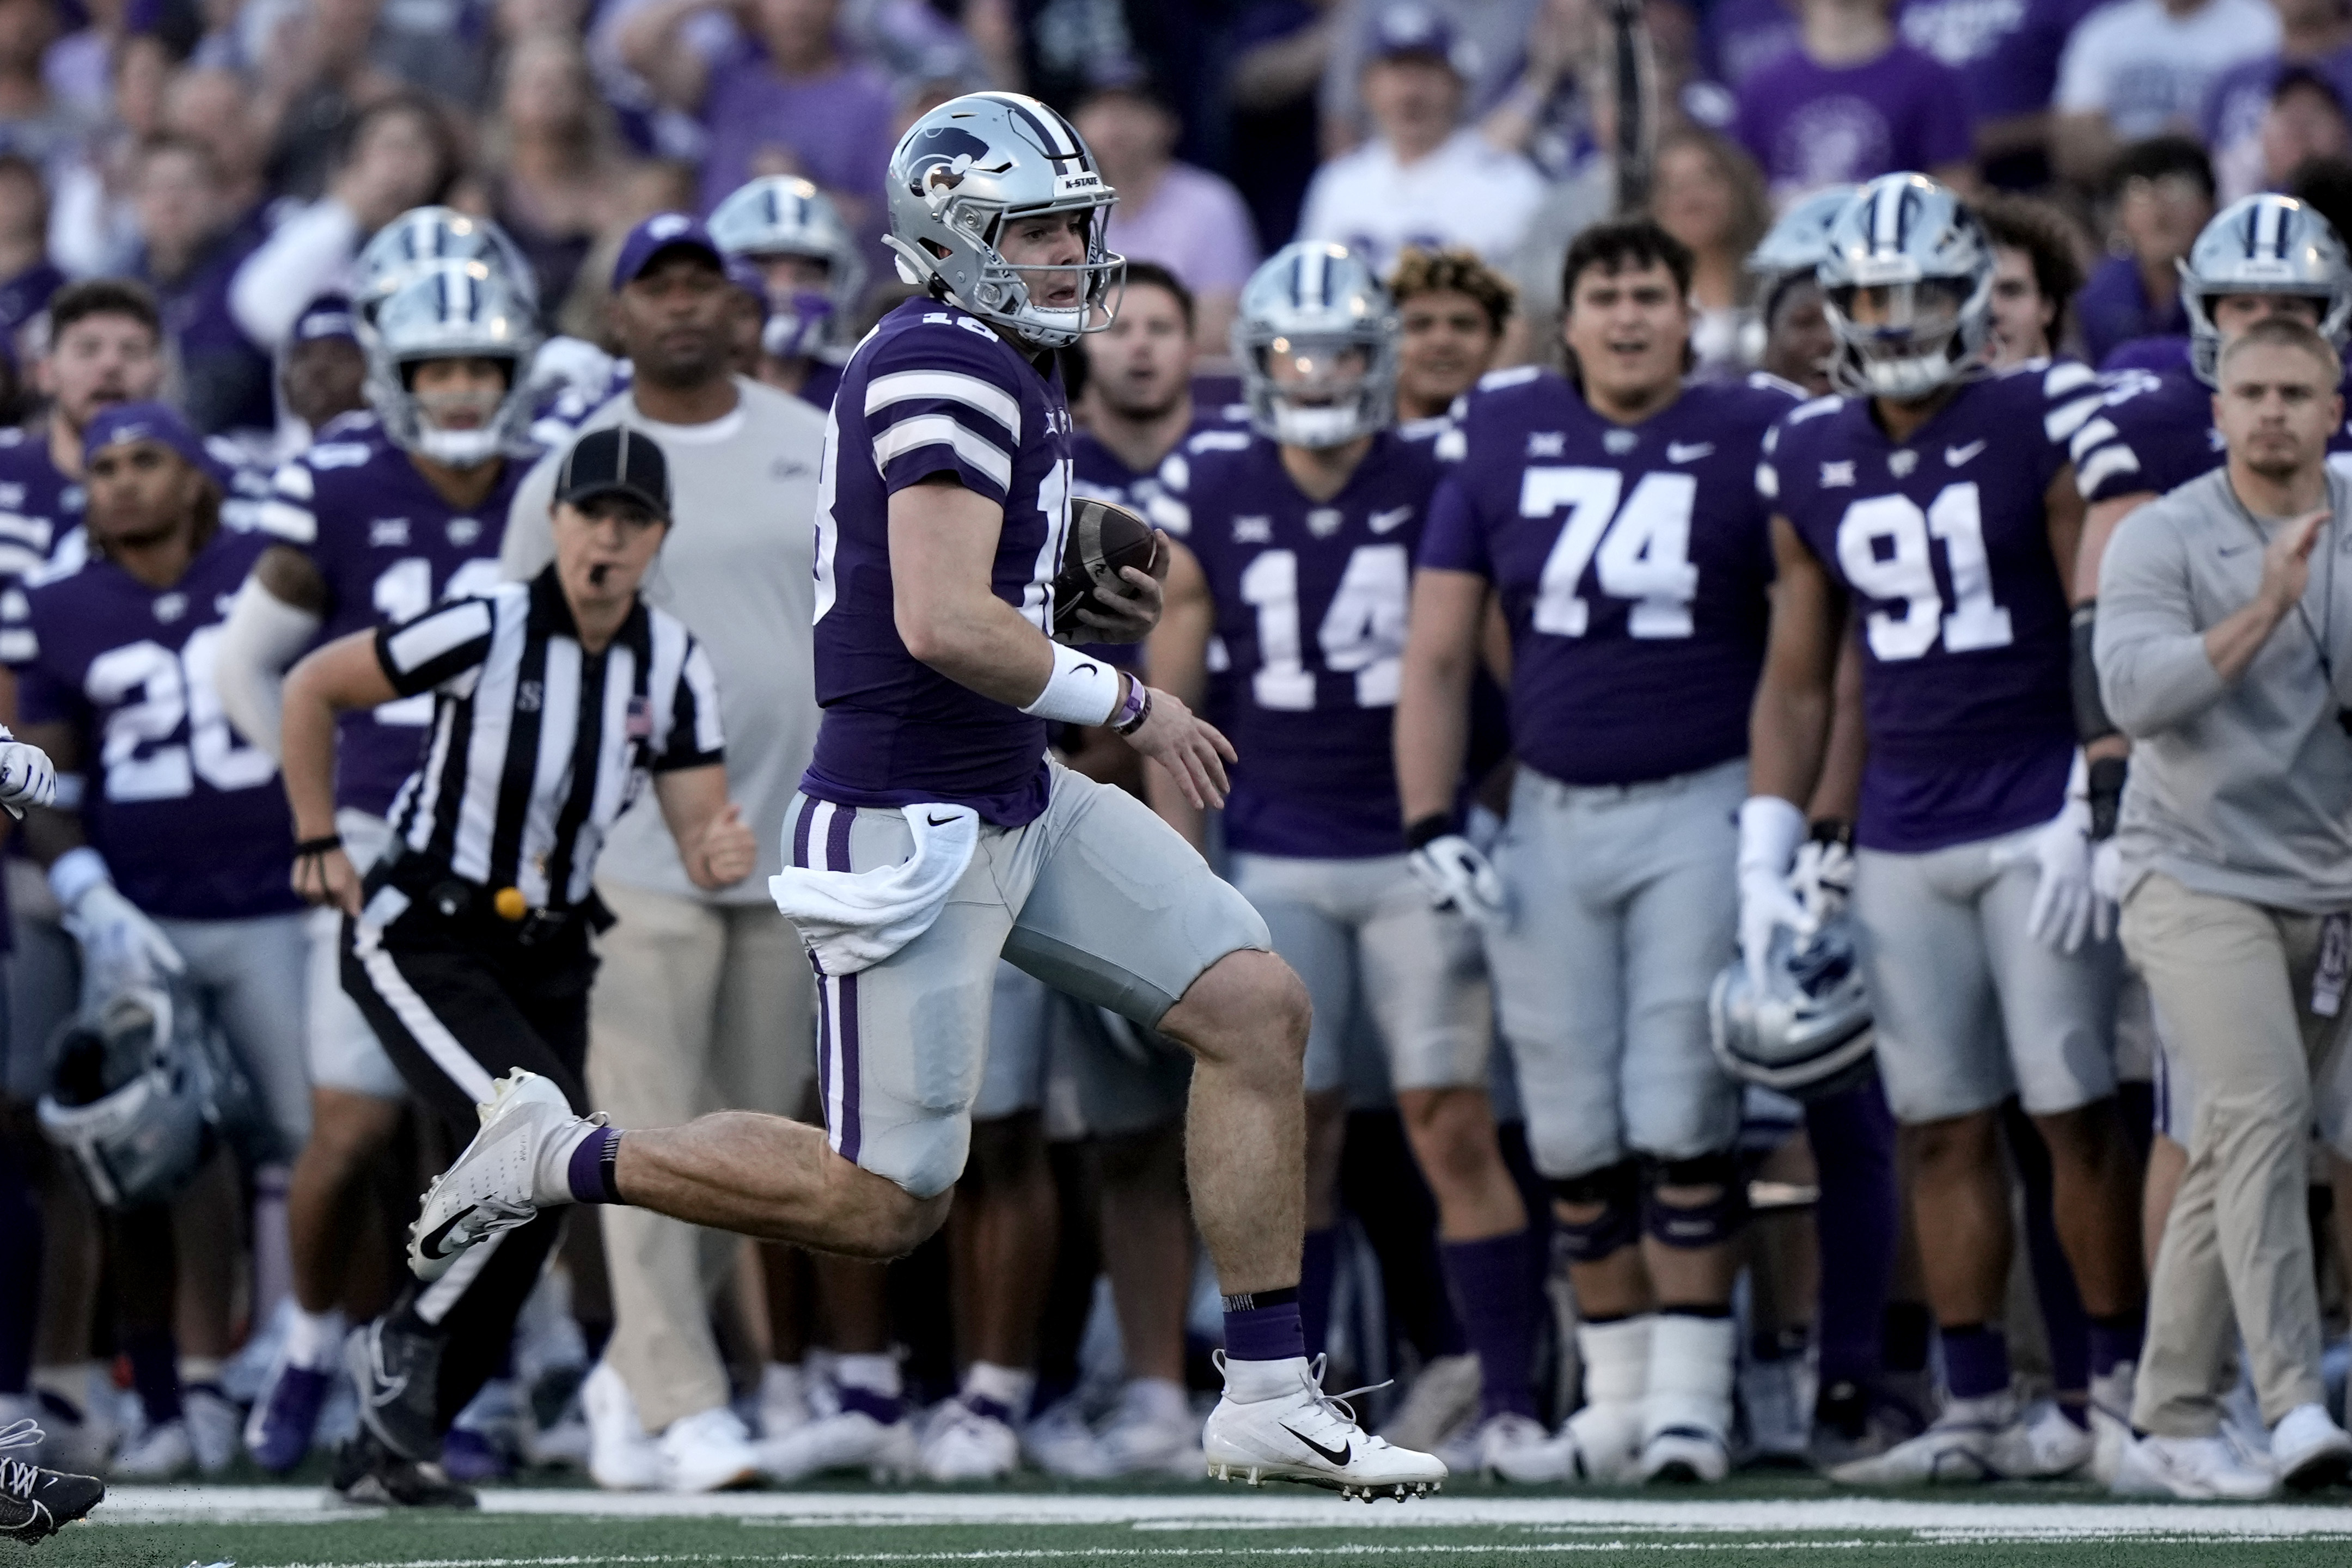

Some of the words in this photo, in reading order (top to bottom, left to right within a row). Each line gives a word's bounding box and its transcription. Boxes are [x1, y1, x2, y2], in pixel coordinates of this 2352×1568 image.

[1065, 176, 1098, 189] K-STATE
[1241, 544, 1408, 712] 14
[1519, 465, 1700, 639] 74
[1836, 481, 2014, 665] 91
